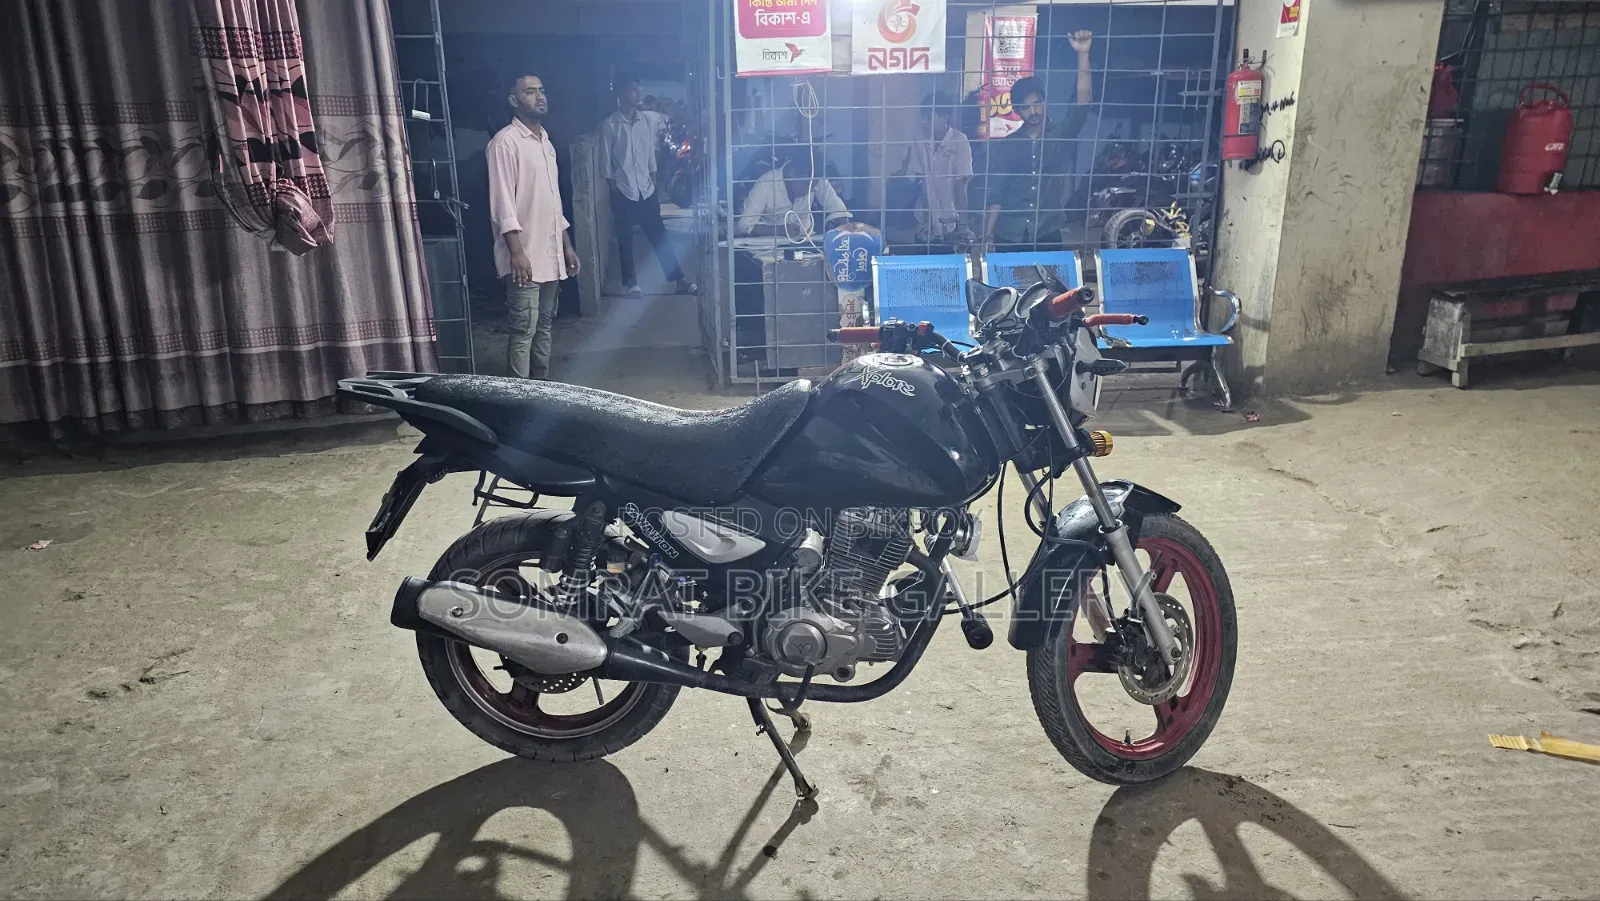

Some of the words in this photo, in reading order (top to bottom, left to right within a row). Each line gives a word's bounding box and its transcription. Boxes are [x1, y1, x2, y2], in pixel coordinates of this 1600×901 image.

[754, 9, 811, 27] বিকাশ-এ
[762, 48, 788, 61] বিকাশ
[868, 47, 930, 71] নগদ
[845, 365, 916, 397] Xplore
[636, 512, 680, 559] WALTON
